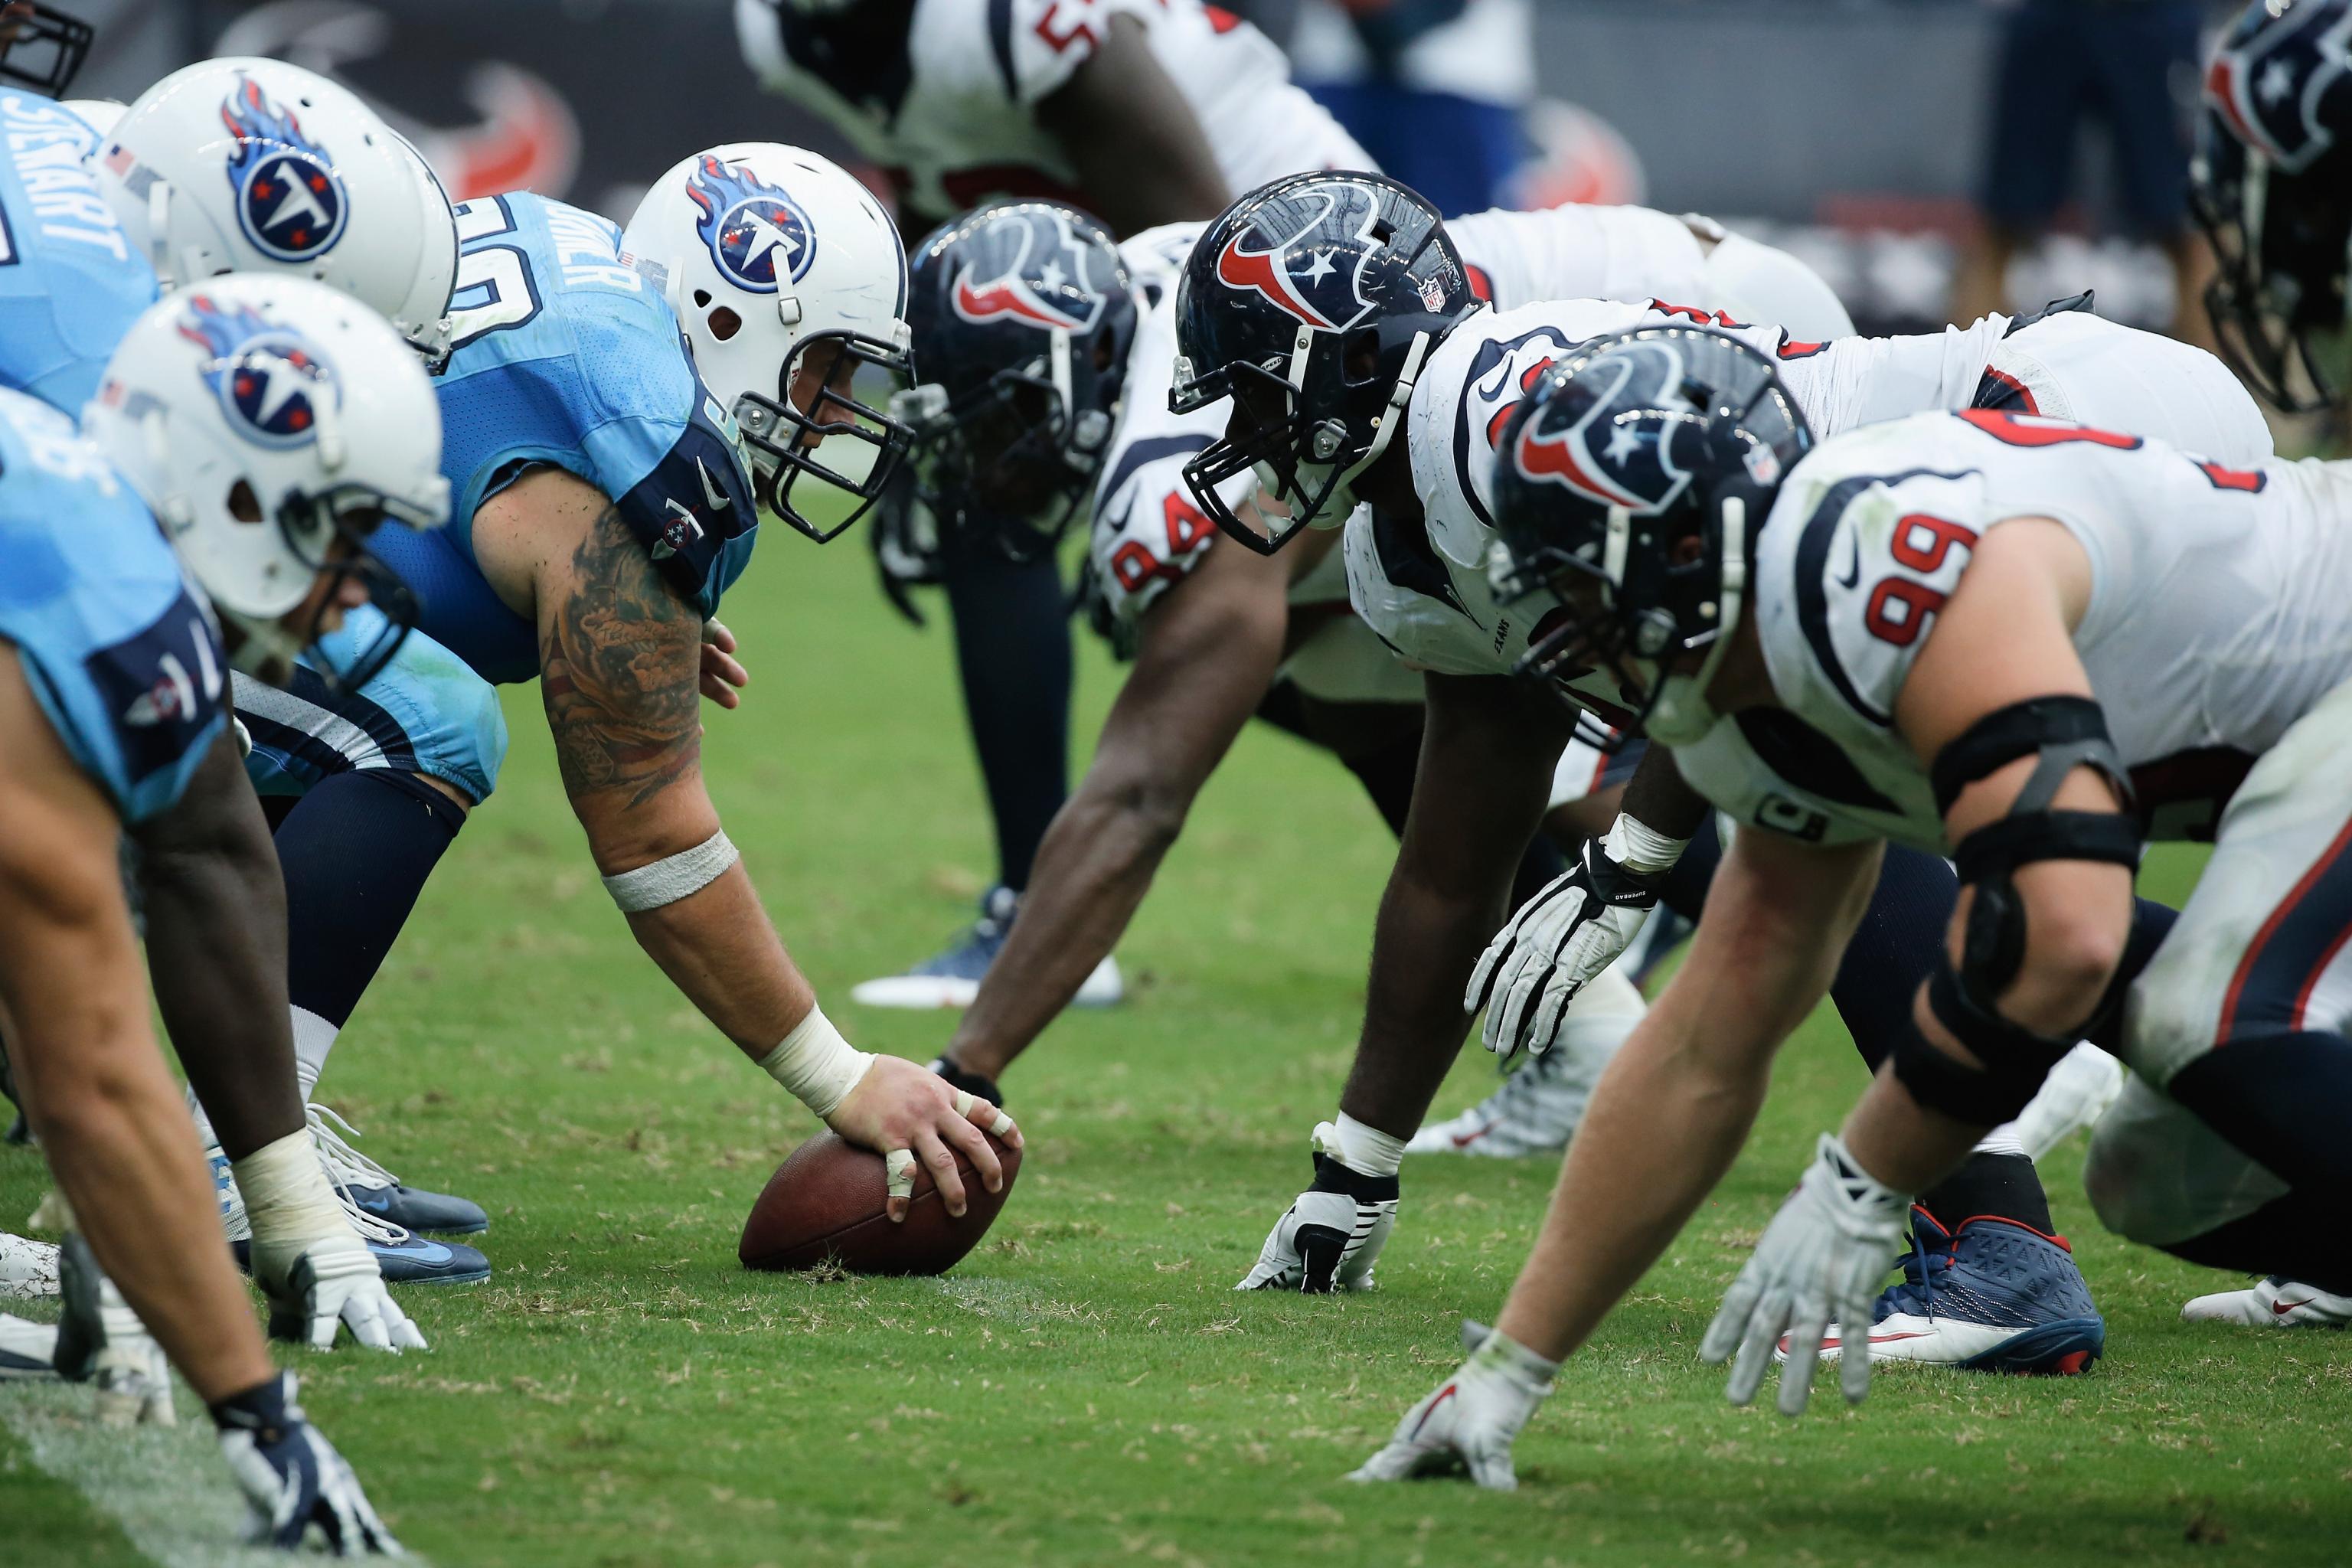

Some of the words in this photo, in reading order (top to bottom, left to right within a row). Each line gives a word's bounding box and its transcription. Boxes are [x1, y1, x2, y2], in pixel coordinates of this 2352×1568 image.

[1112, 490, 1218, 593] 94
[1864, 514, 1978, 648] 99
[1615, 890, 1646, 900] SUPERBAD
